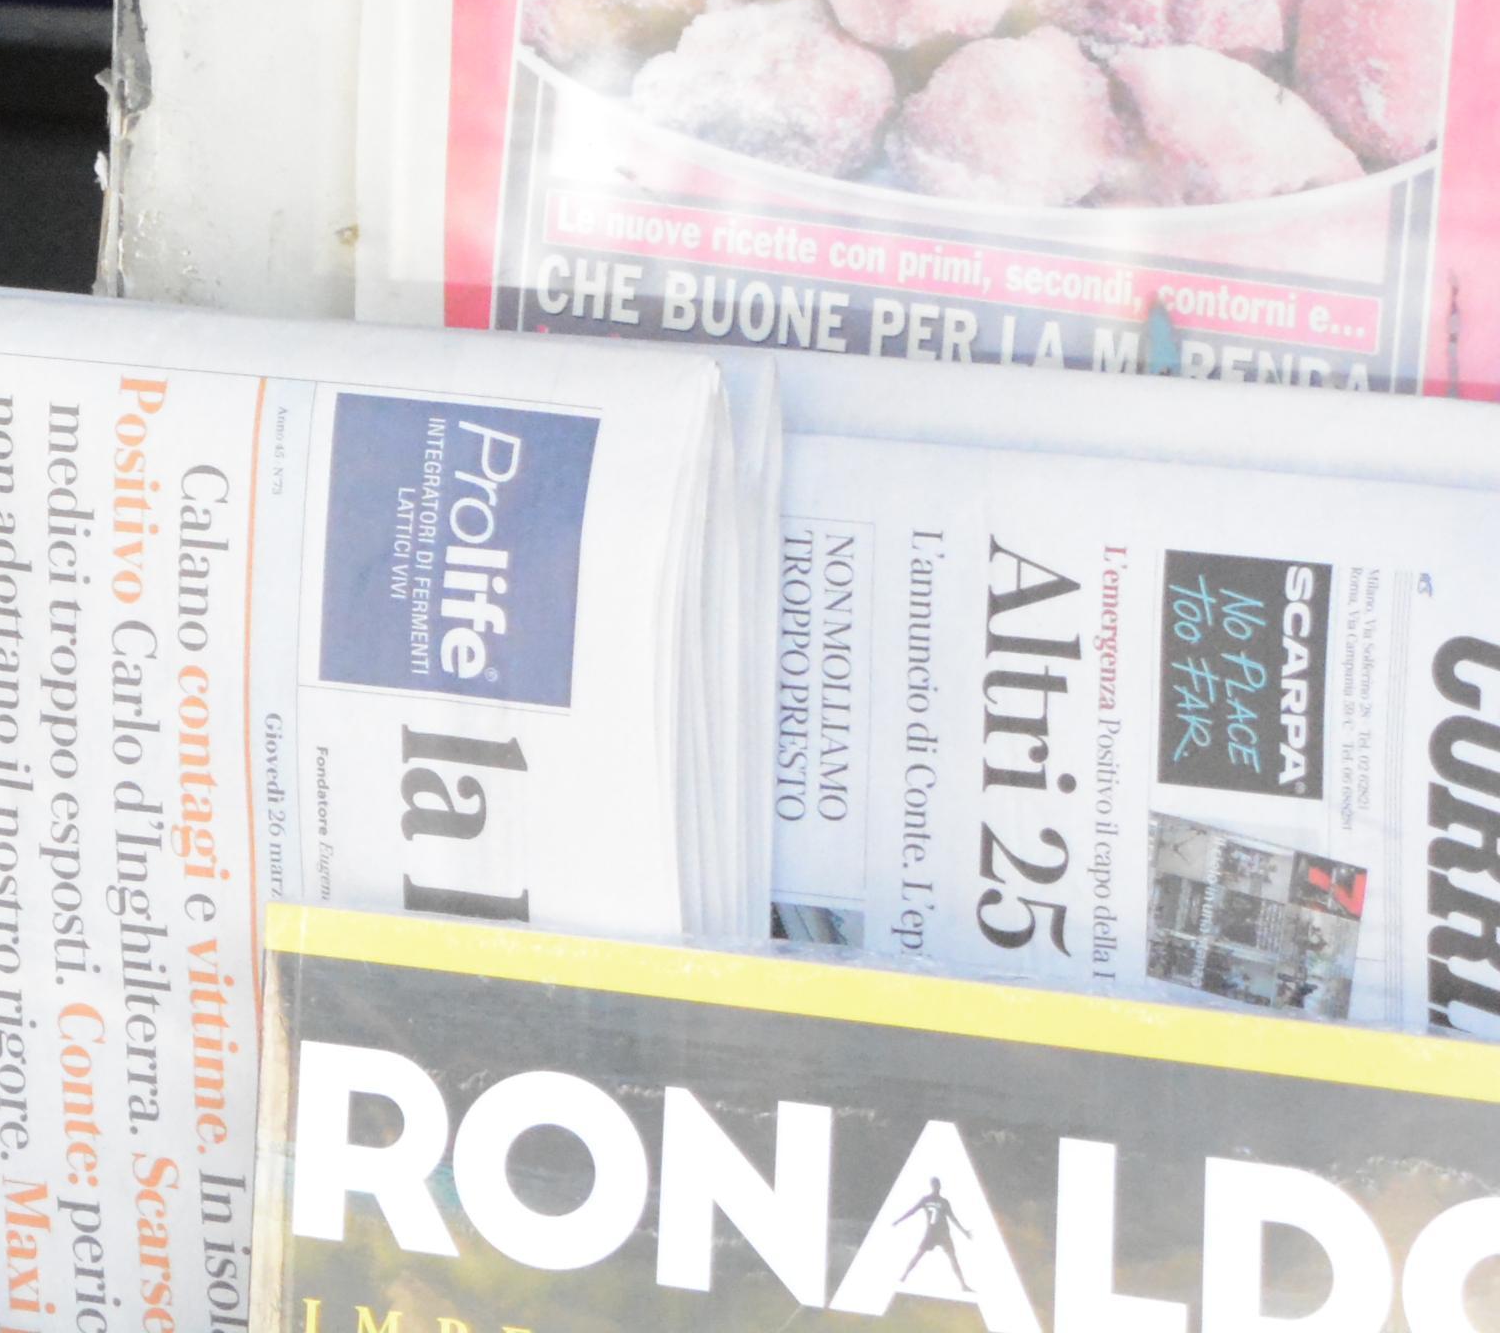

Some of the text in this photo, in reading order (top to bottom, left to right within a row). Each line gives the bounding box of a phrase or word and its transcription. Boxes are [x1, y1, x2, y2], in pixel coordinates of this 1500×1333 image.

[536, 253, 1066, 371] CHE BUONE PER LA
[37, 399, 107, 1188] medici troppo esposti. Conte:
[105, 372, 172, 1136] Positivo Carlo d'Inghilterra.
[264, 713, 287, 837] Giovedì 26
[401, 723, 529, 842] la
[774, 528, 815, 823] TROPPO PRESTO
[816, 533, 857, 823] NON MOLLIAMO
[975, 532, 1084, 959] Altri 25
[1278, 565, 1315, 786] SCARPA
[170, 463, 247, 1225] Calano contagi e vittime. In
[1, 1173, 57, 1315] Maxi
